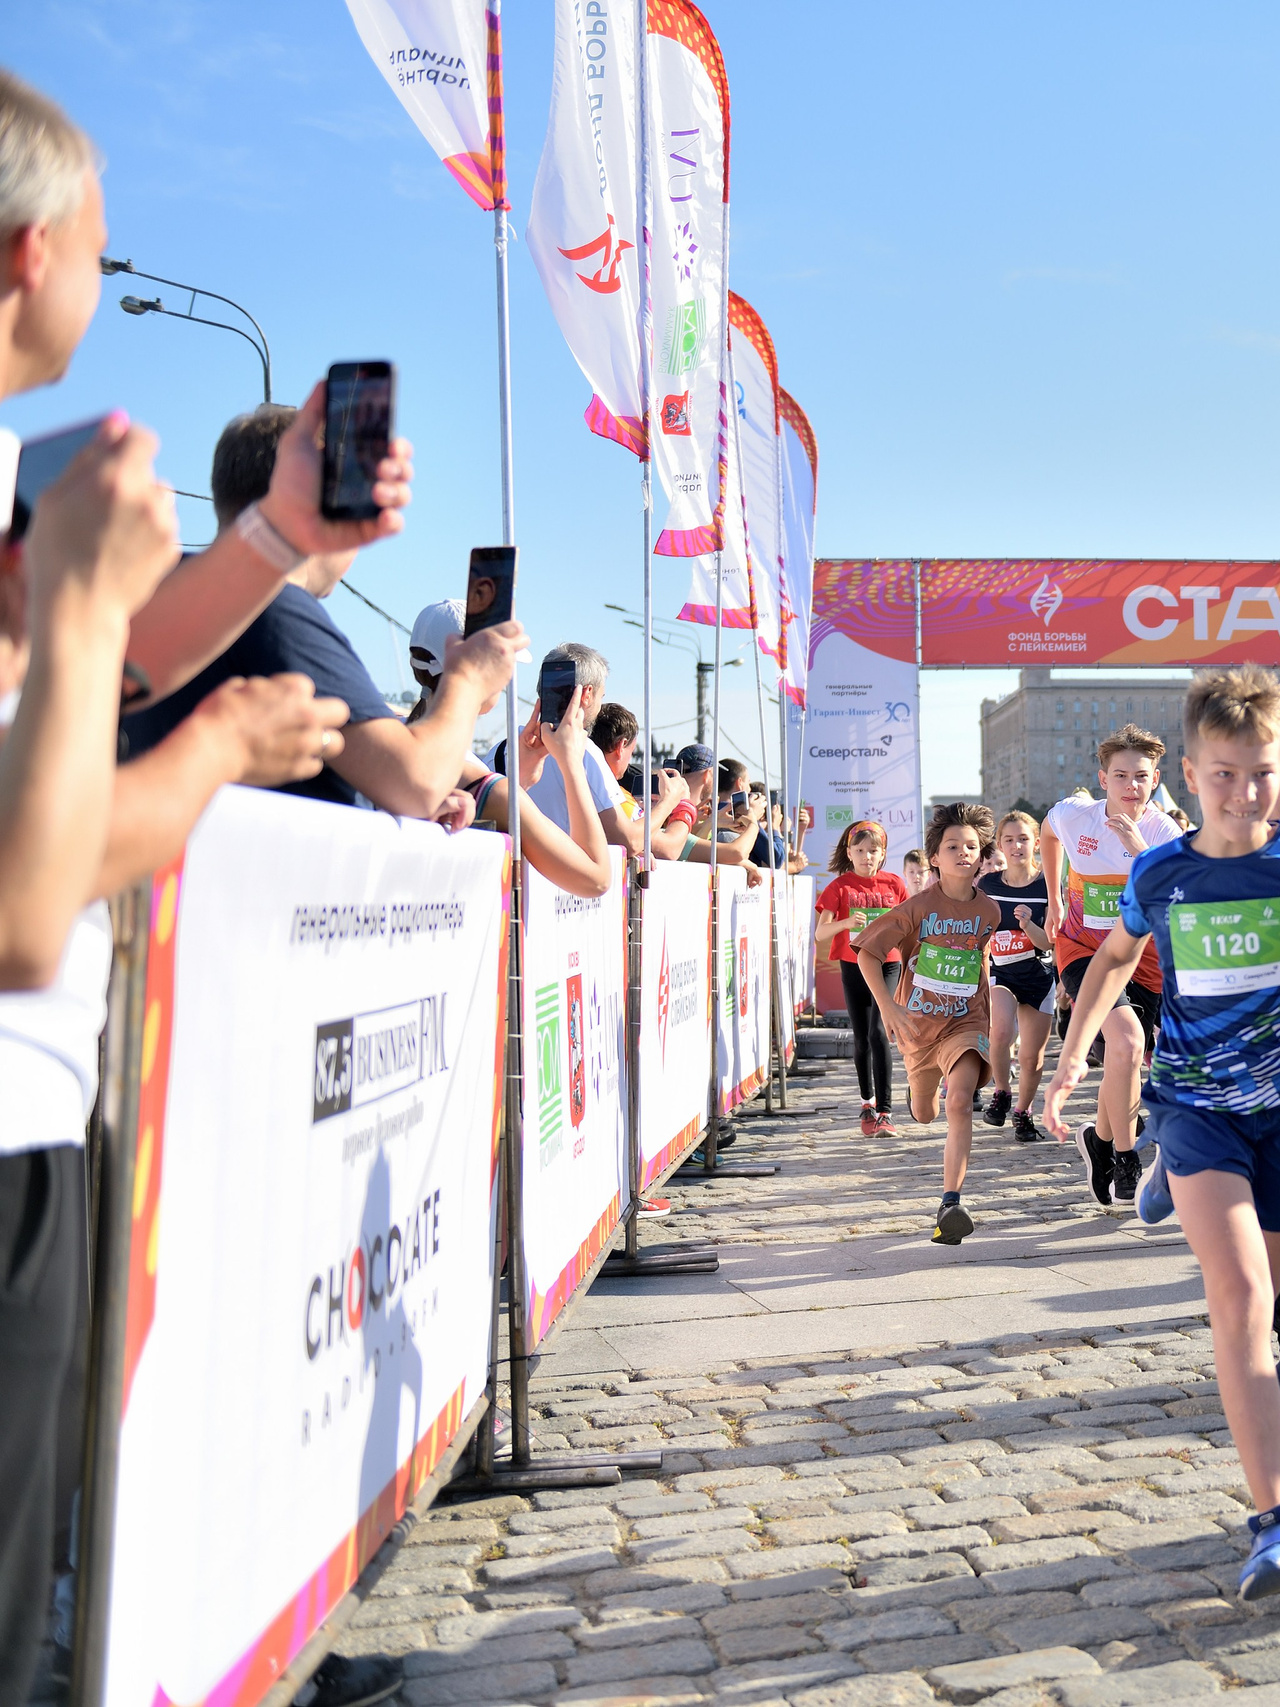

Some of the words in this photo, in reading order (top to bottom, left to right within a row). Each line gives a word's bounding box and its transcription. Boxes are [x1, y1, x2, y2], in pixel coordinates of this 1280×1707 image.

[1008, 632, 1041, 644] ФОНД
[1044, 632, 1087, 642] БОРЬБЫ
[1008, 642, 1016, 652] С
[1018, 641, 1087, 653] ЛЕЙКЕМИЕЙ
[809, 745, 888, 762] Северсталь
[1100, 900, 1120, 912] 117
[919, 912, 980, 940] Normal
[994, 941, 1024, 952] 10748
[1202, 932, 1260, 957] 1120
[936, 963, 965, 978] 1141
[315, 1035, 353, 1110] 87,5
[356, 1019, 418, 1087] BUSINESS
[418, 991, 449, 1081] FM
[303, 1187, 441, 1363] CHOCOLATE
